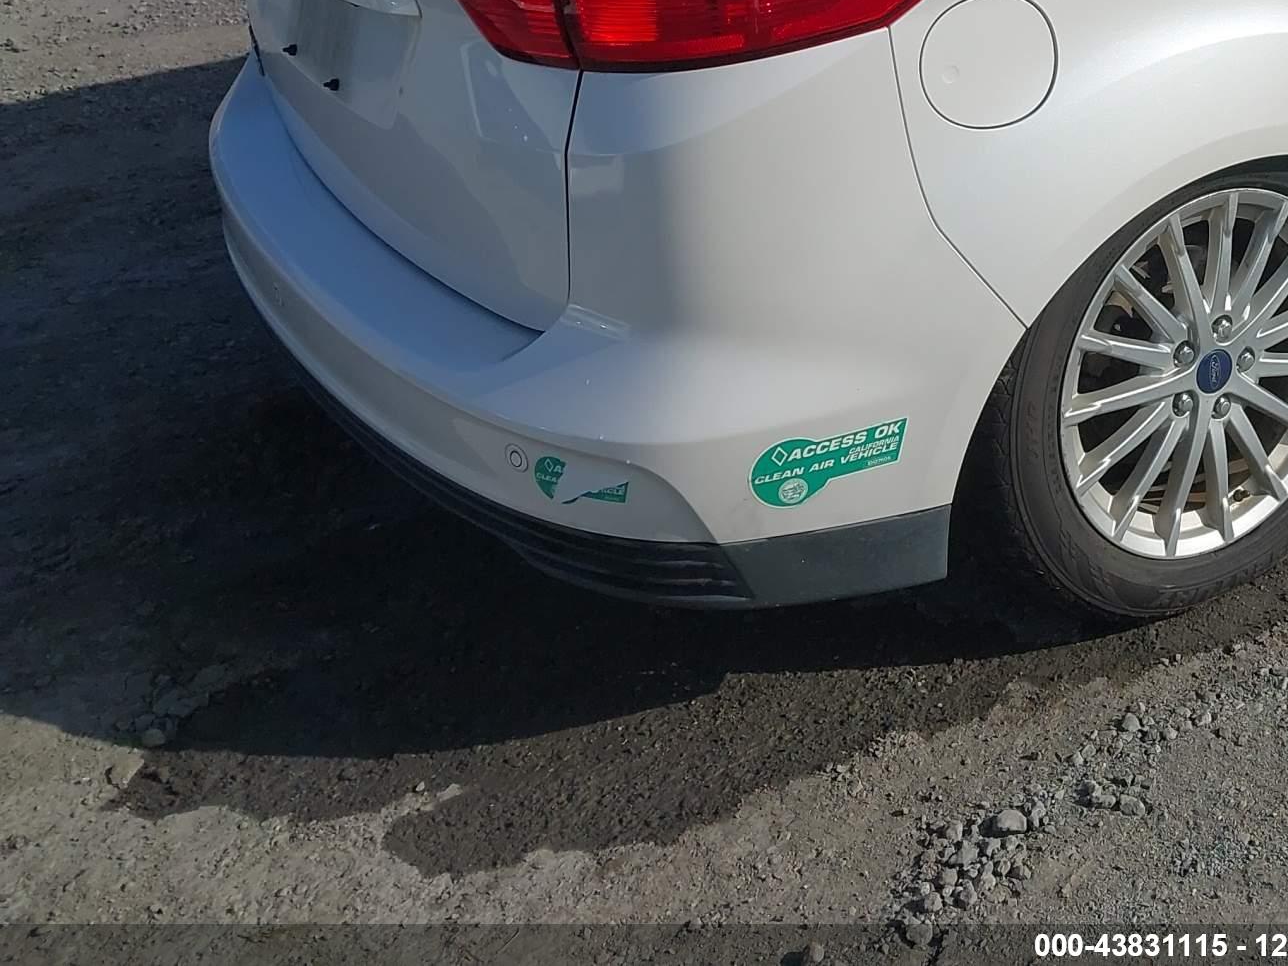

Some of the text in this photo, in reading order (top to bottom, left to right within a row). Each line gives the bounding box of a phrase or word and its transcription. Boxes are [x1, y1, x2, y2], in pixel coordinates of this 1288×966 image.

[787, 420, 904, 462] ACCESS OK
[849, 435, 900, 455] CALIFORNIA
[536, 472, 557, 483] CLEA
[754, 467, 805, 485] CLEAN
[809, 459, 835, 473] AIR
[840, 442, 898, 464] VEHICLE
